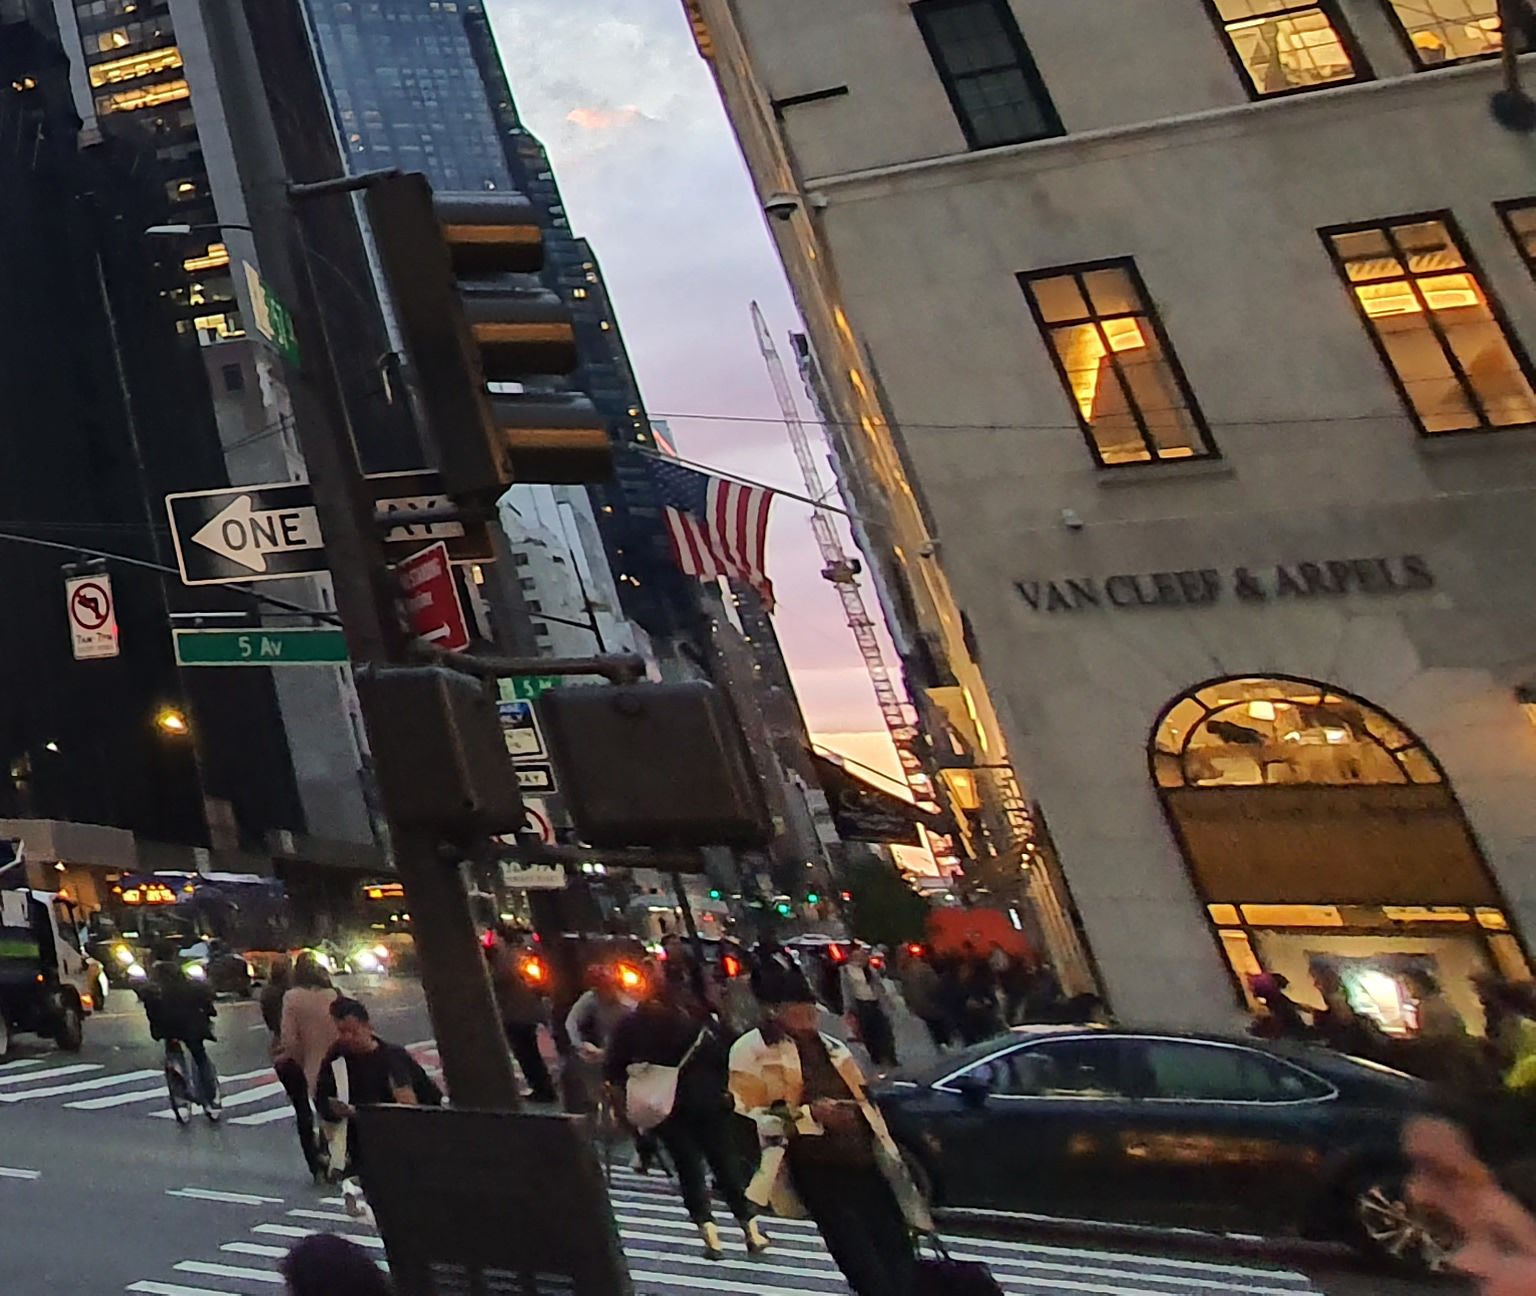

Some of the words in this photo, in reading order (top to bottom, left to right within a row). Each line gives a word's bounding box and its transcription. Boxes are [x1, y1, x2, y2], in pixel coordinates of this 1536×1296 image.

[221, 513, 307, 552] ONE
[1013, 576, 1099, 611] VAN
[1104, 568, 1219, 607] CLEEF
[1234, 566, 1267, 602] &
[1274, 555, 1435, 597] ARPELS
[238, 636, 252, 657] 5
[260, 637, 282, 656] Av
[523, 679, 534, 697] 5
